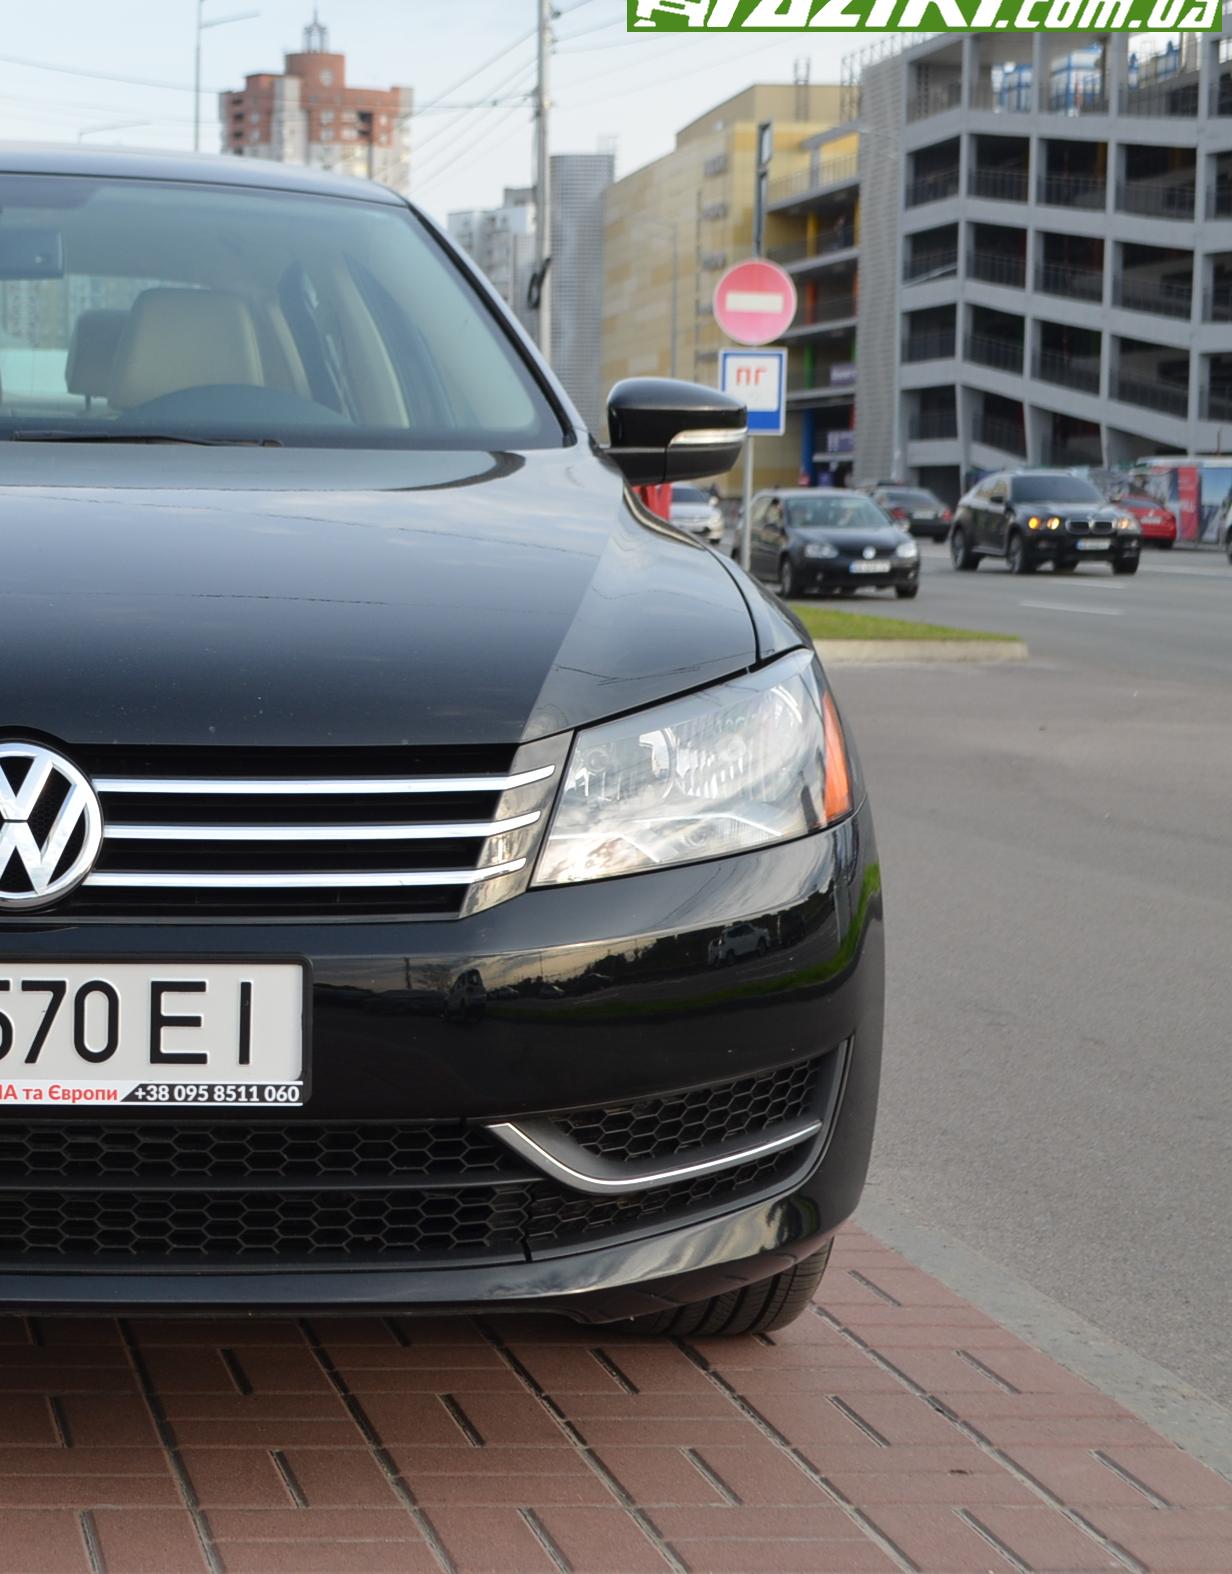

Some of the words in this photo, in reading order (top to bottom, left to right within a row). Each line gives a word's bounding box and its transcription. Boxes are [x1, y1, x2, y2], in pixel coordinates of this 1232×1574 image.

[150, 980, 252, 1065] EI
[23, 1087, 43, 1101] та
[48, 1084, 118, 1103] Європи
[134, 1085, 169, 1101] +38
[174, 1085, 208, 1101] 095
[213, 1086, 259, 1102] 8511
[264, 1086, 300, 1102] 060
